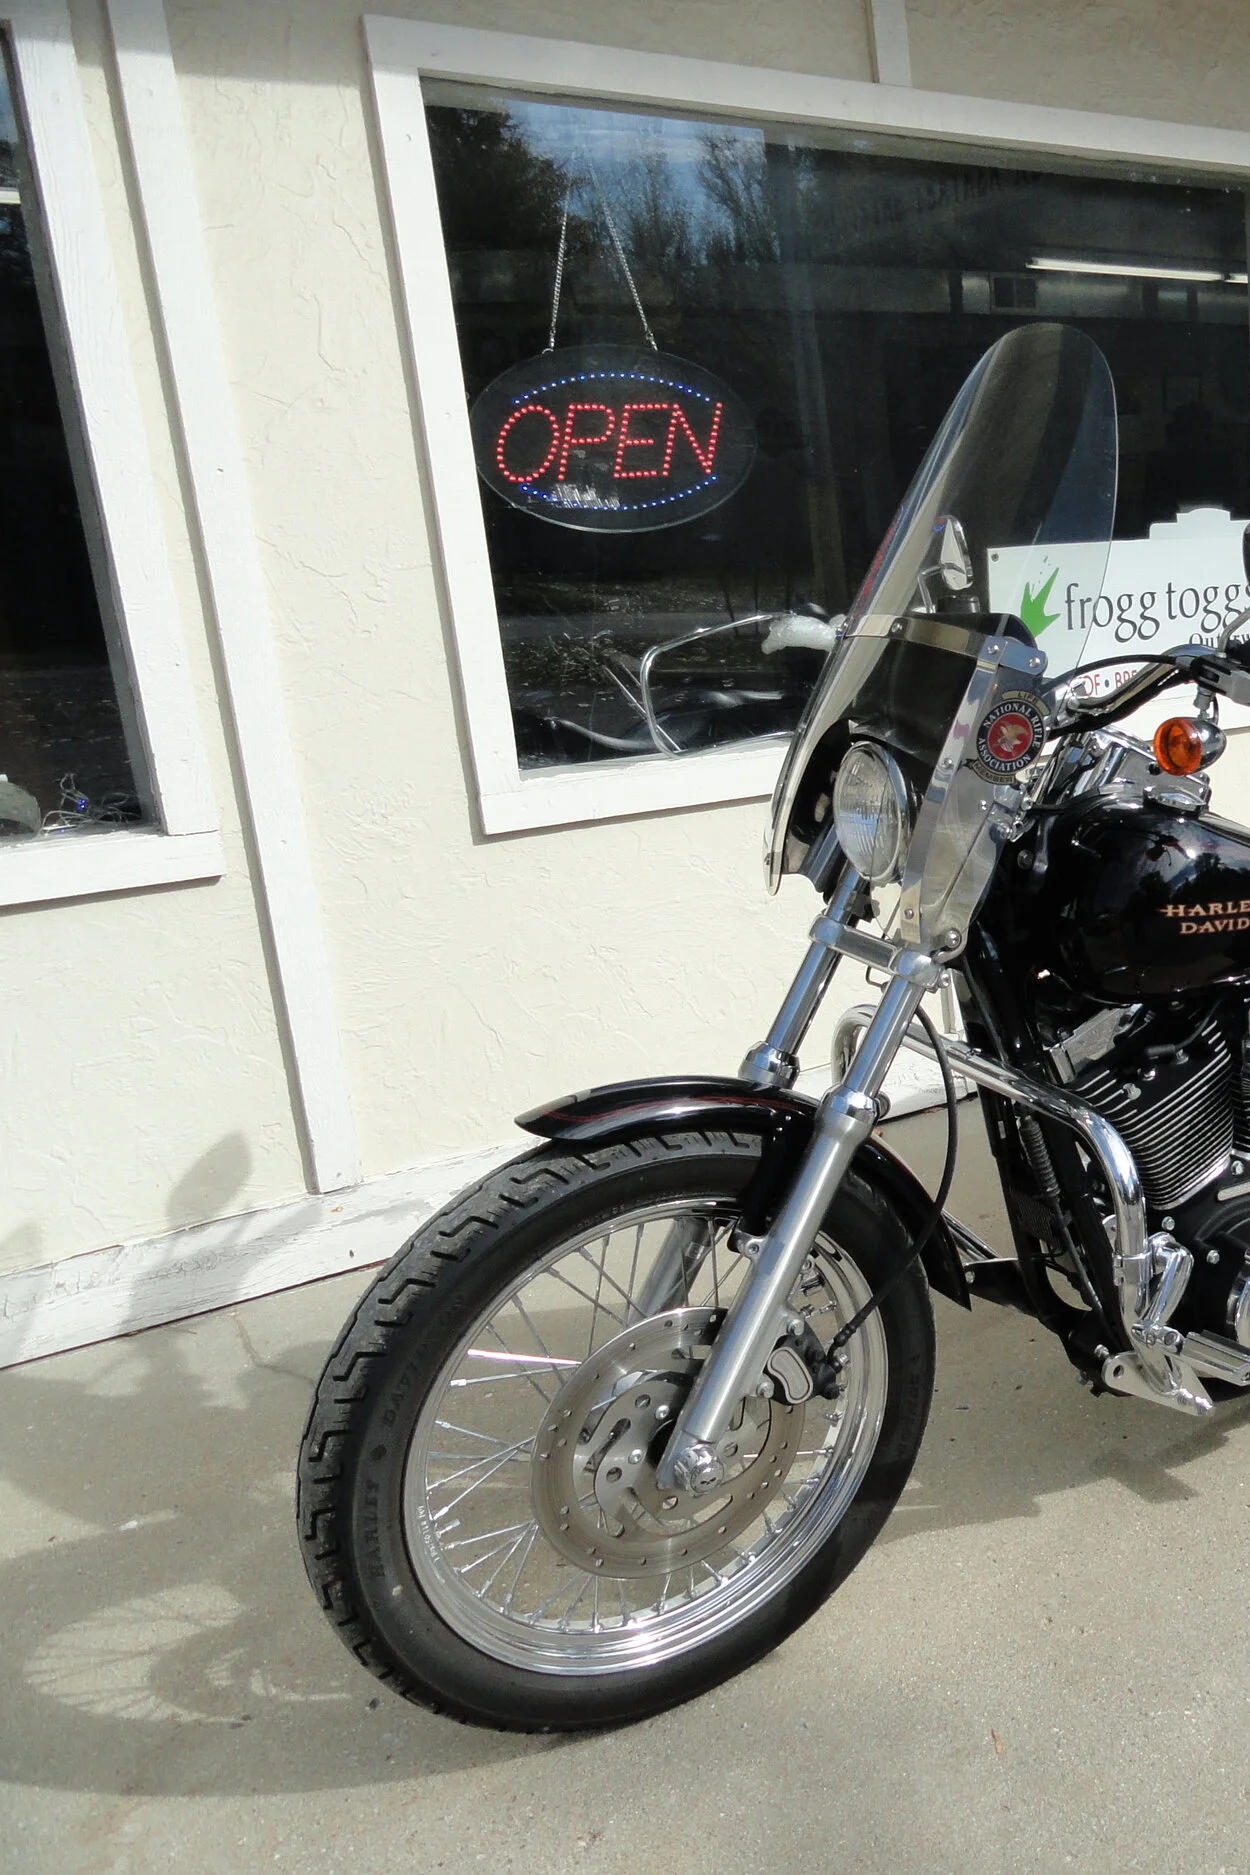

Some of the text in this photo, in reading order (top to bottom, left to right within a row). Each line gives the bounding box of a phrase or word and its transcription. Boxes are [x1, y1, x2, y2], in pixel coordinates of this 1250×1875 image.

[496, 402, 723, 483] OPEN
[1065, 583, 1161, 644] frogg
[983, 703, 1044, 748] NATIONAL RIFLE
[978, 737, 1032, 771] ASSOCIATION
